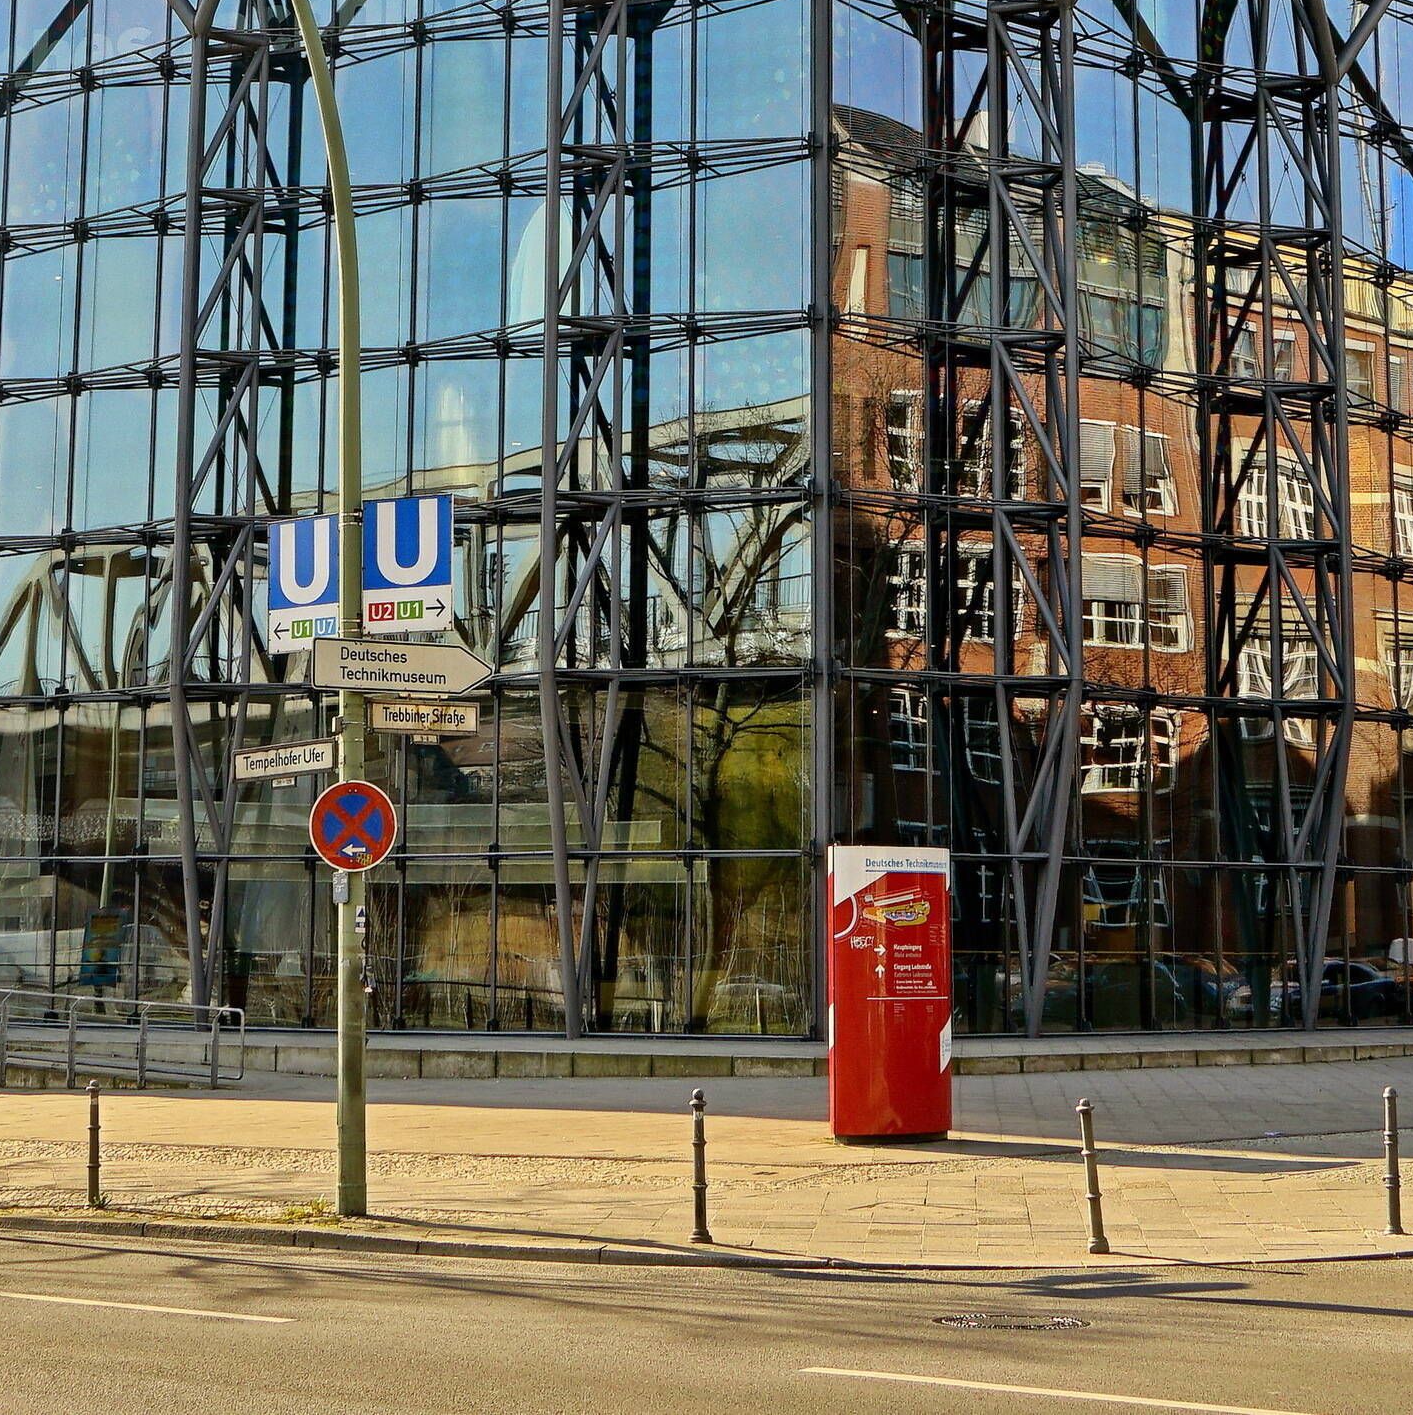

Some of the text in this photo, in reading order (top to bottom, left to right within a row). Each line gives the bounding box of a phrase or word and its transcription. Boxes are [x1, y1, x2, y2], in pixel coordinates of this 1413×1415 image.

[377, 498, 438, 586] U
[280, 518, 330, 604] U
[371, 603, 419, 620] U2 U1
[293, 619, 334, 637] U1 U7
[340, 646, 407, 664] Deutsches
[340, 666, 446, 685] Technikmuseum
[382, 706, 466, 727] Trebbiner Straße
[243, 747, 325, 774] Tempelhofer Ufer
[865, 857, 904, 868] Deutsches
